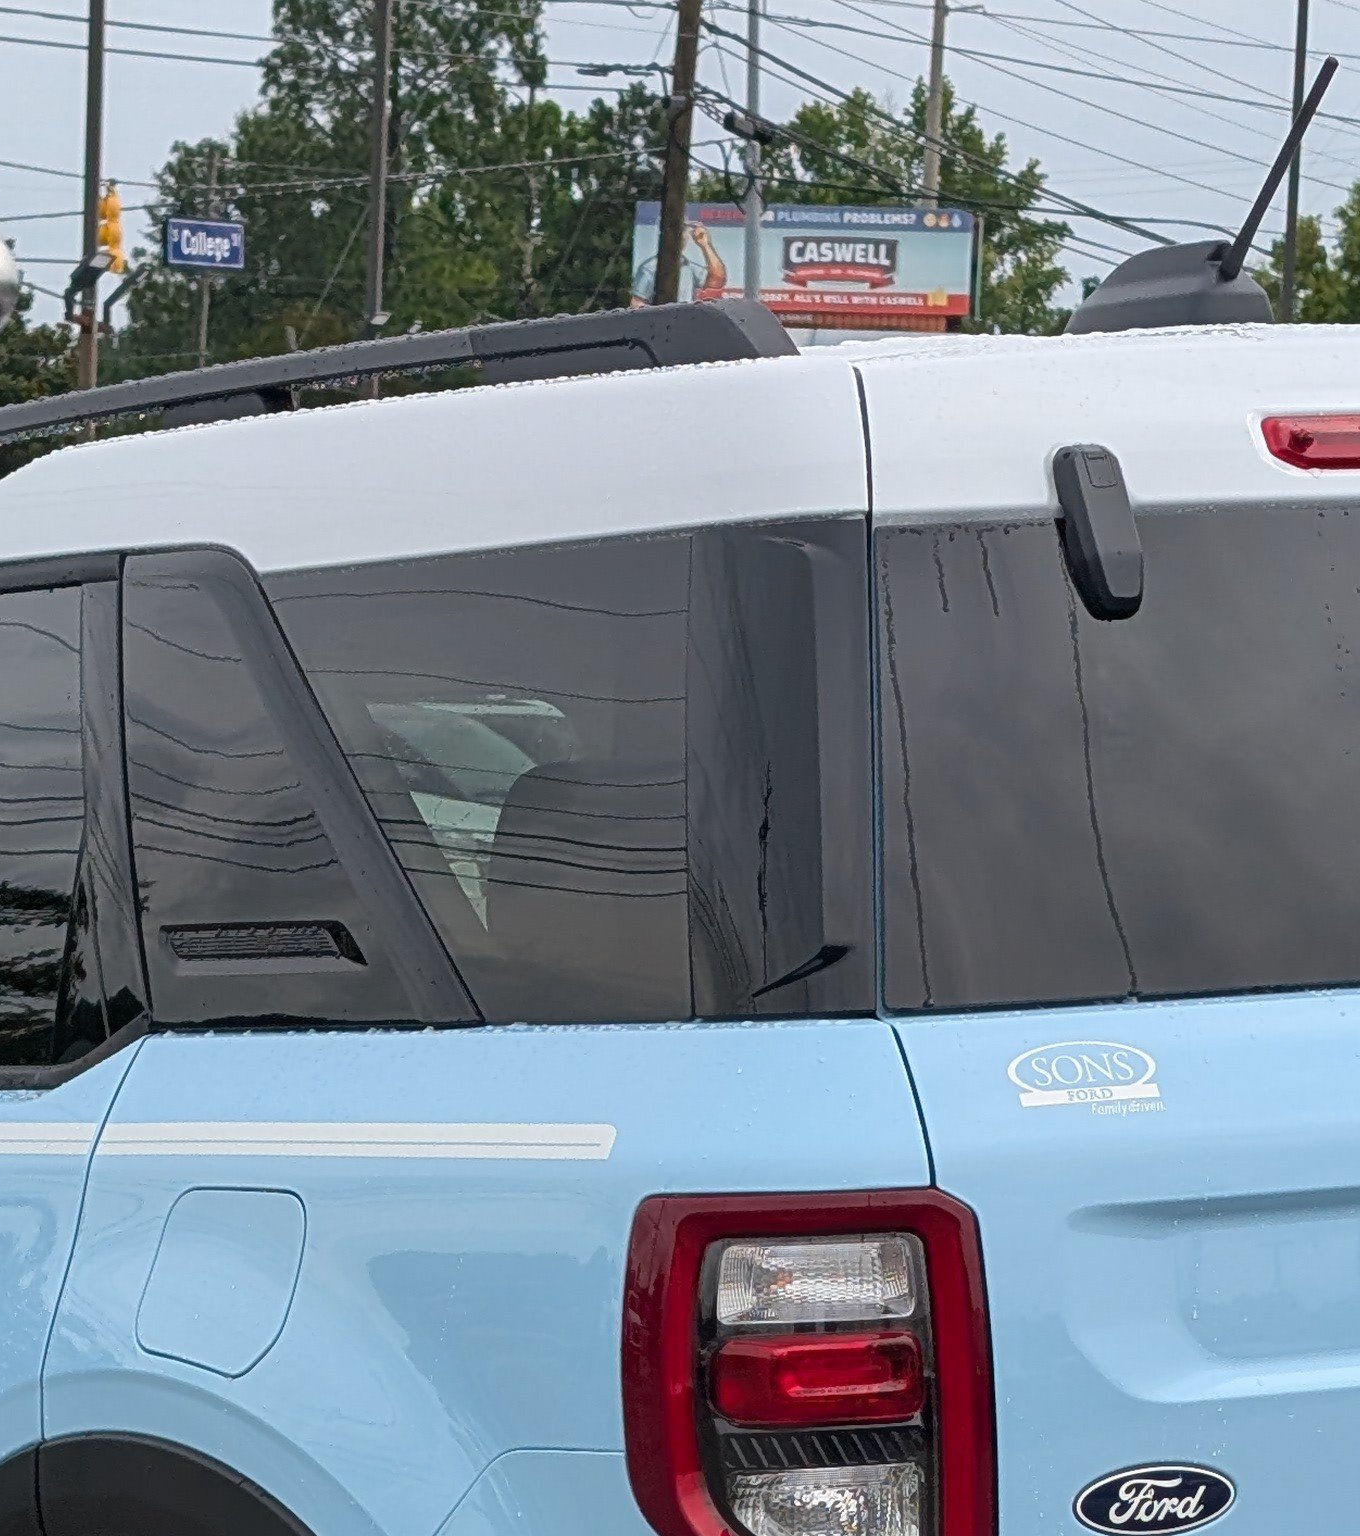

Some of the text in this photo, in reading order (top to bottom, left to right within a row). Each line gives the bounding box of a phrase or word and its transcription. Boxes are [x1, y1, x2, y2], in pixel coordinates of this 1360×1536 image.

[843, 211, 917, 225] PROBLEMS?
[181, 229, 231, 262] College
[789, 241, 891, 267] CASWELL
[879, 295, 924, 306] CASWELL
[1031, 1051, 1134, 1086] SONS
[1066, 1088, 1114, 1102] FORD
[1108, 1479, 1207, 1525] Ford
